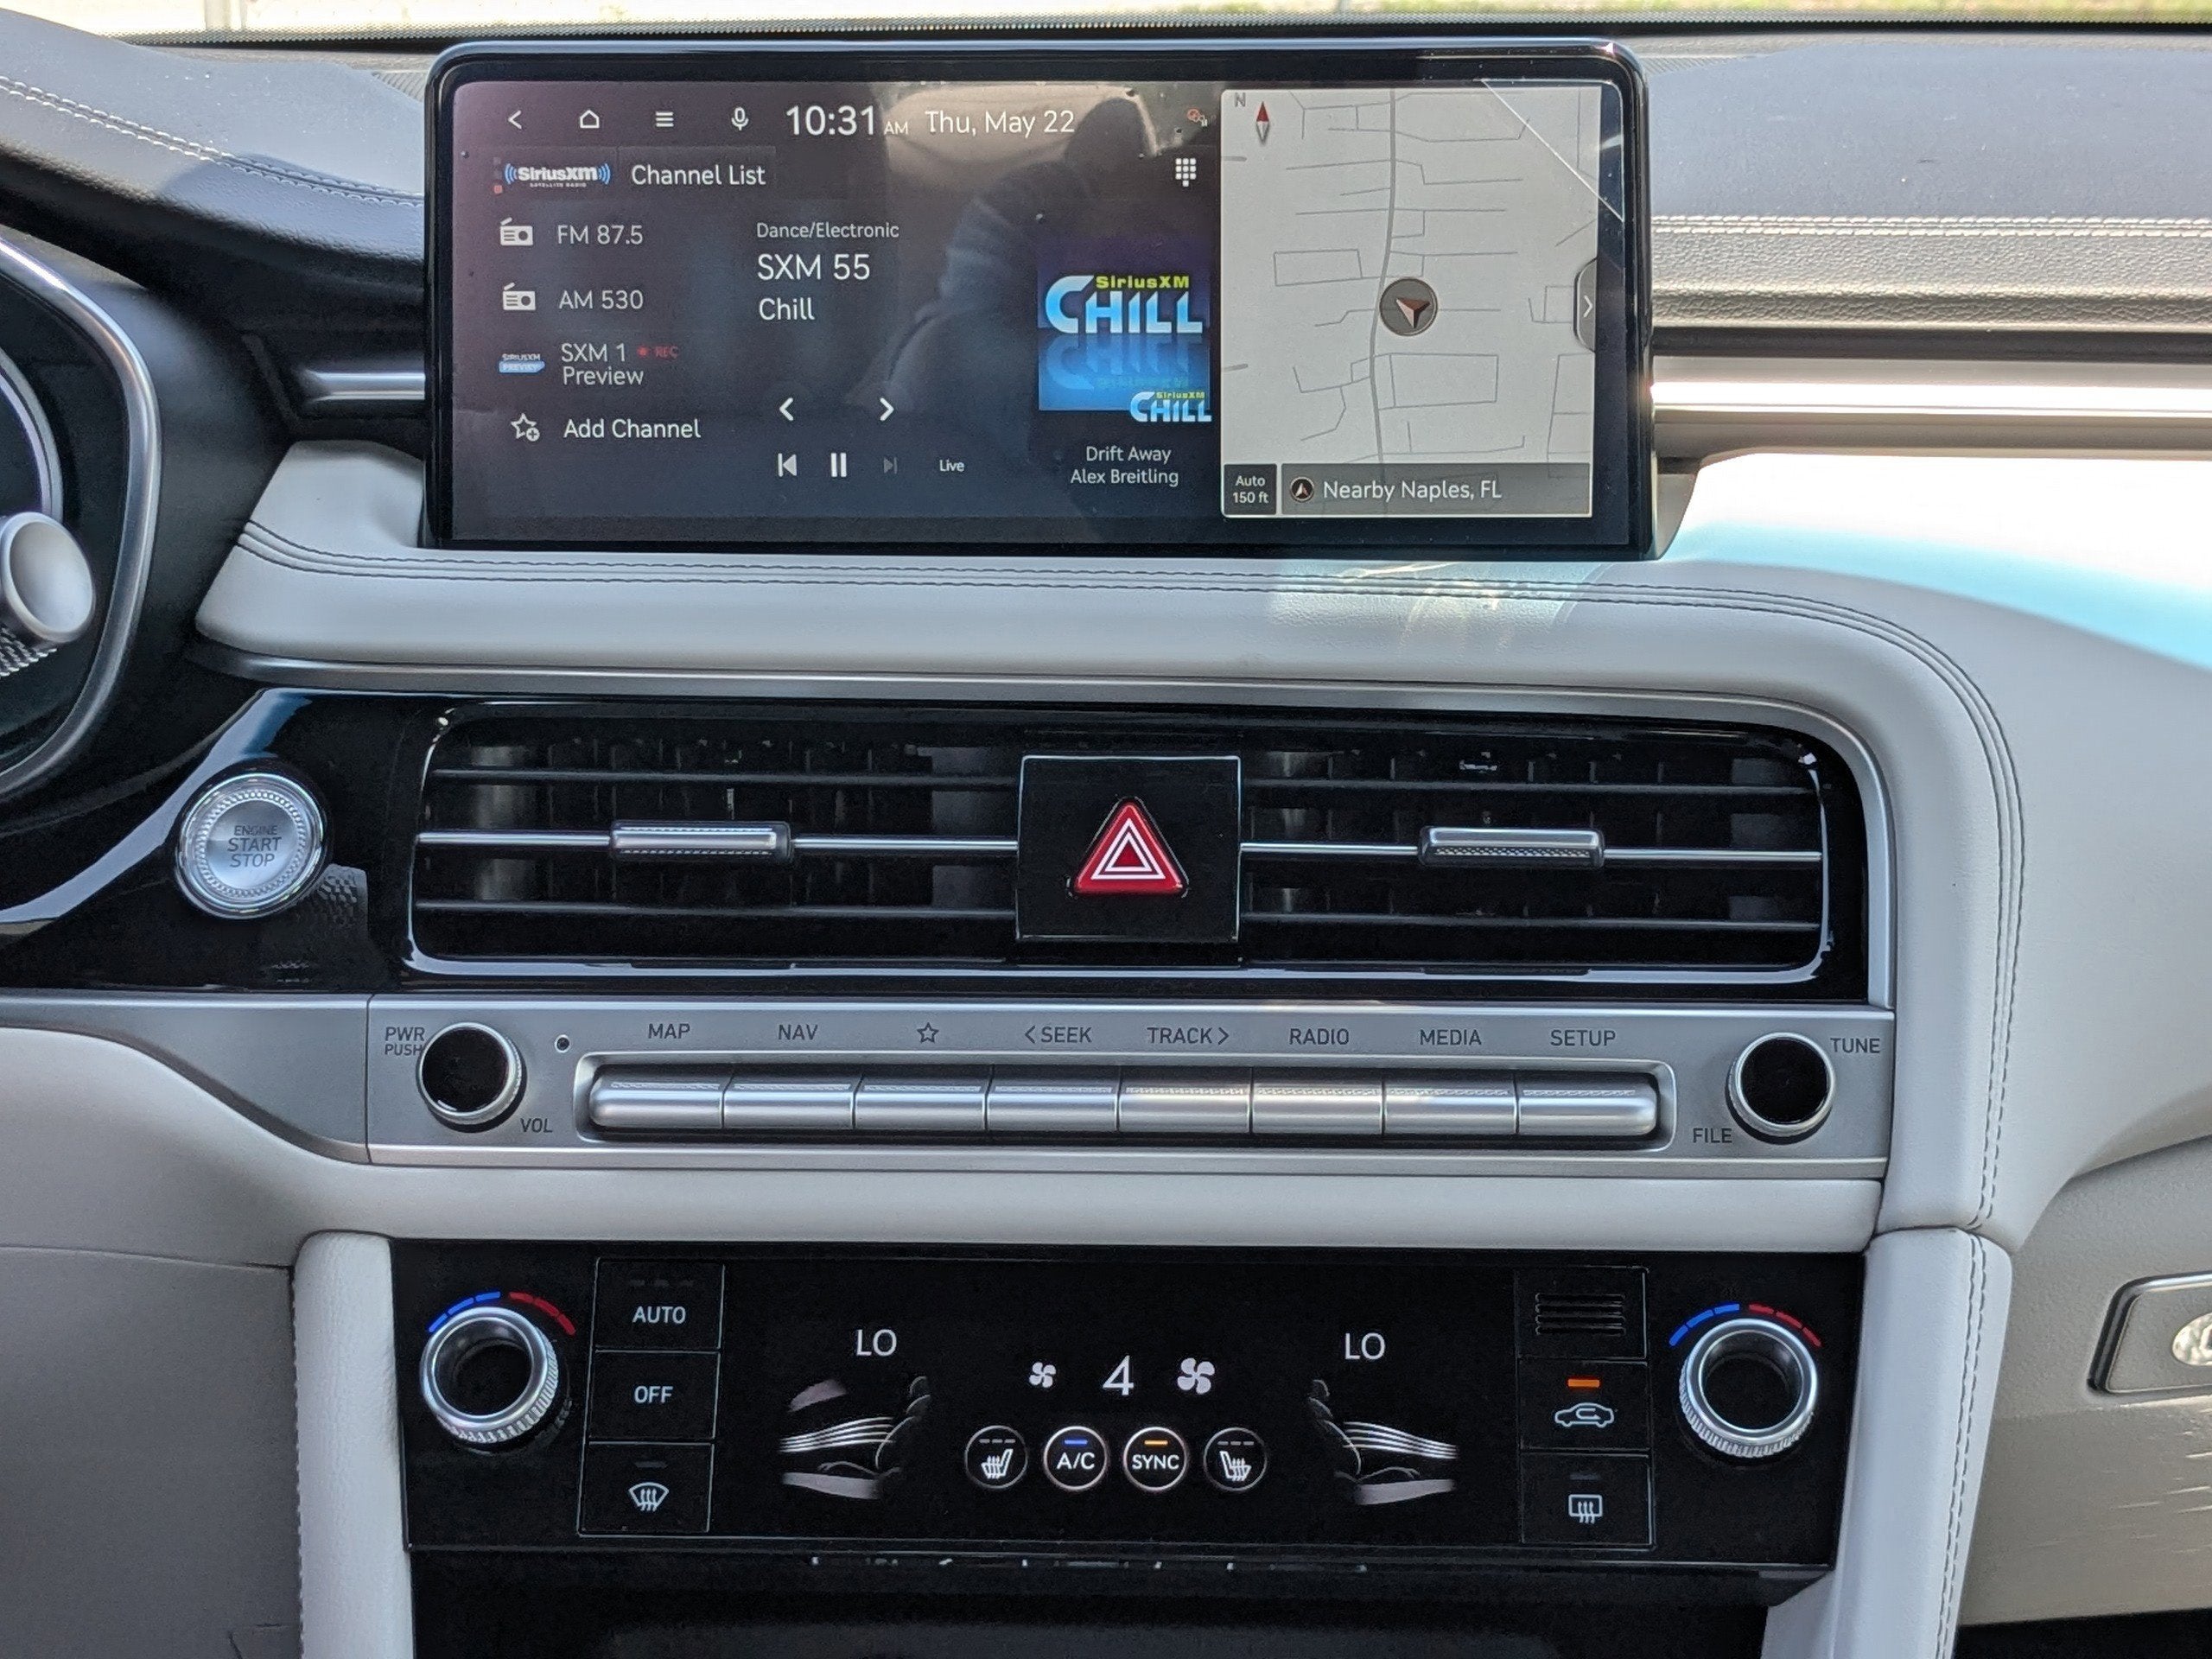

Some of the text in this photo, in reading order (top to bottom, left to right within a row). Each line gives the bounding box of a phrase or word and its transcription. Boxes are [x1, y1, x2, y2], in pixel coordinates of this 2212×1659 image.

[1234, 92, 1246, 107] N
[786, 105, 1075, 139] 10:31 AM Thu, May 22
[631, 164, 766, 185] Channel List
[557, 225, 644, 245] FM 87.5
[756, 222, 899, 239] Dance/Electronic
[757, 254, 870, 280] SXM 55
[1096, 276, 1190, 289] SiriusXM
[559, 290, 644, 309] AM 530
[1045, 275, 1203, 334] CHILL
[759, 298, 815, 321] Chill
[561, 343, 626, 362] SXM 1
[563, 365, 645, 385] Preview
[1130, 391, 1211, 422] CHILL
[564, 420, 702, 439] Add Channel
[1086, 446, 1172, 467] Drift Away
[939, 460, 965, 473] Live
[1071, 468, 1179, 488] Alex Breitling
[1235, 474, 1266, 488] Auto
[1232, 490, 1269, 505] 150 ft
[1323, 480, 1503, 502] Nearby Naples, FL
[226, 836, 283, 852] START
[229, 853, 276, 868] STOP
[385, 1027, 425, 1042] PWR
[647, 1023, 690, 1039] MAP
[778, 1024, 819, 1040] NAV
[1040, 1027, 1093, 1044] SEEK
[1147, 1027, 1213, 1045] TRACK
[1289, 1027, 1350, 1046] RADIO
[1419, 1028, 1483, 1046] MEDIA
[1550, 1030, 1617, 1047] SETUP
[384, 1042, 423, 1056] PUSH
[1830, 1037, 1881, 1055] TUNE
[519, 1117, 553, 1134] VOL
[1692, 1128, 1732, 1144] FILE
[632, 1306, 687, 1325] AUTO
[855, 1329, 898, 1357] LO
[1344, 1332, 1386, 1361] LO
[1103, 1355, 1135, 1396] 4
[633, 1386, 673, 1403] OFF
[1056, 1452, 1096, 1471] A/C
[1131, 1454, 1180, 1471] SYNC
